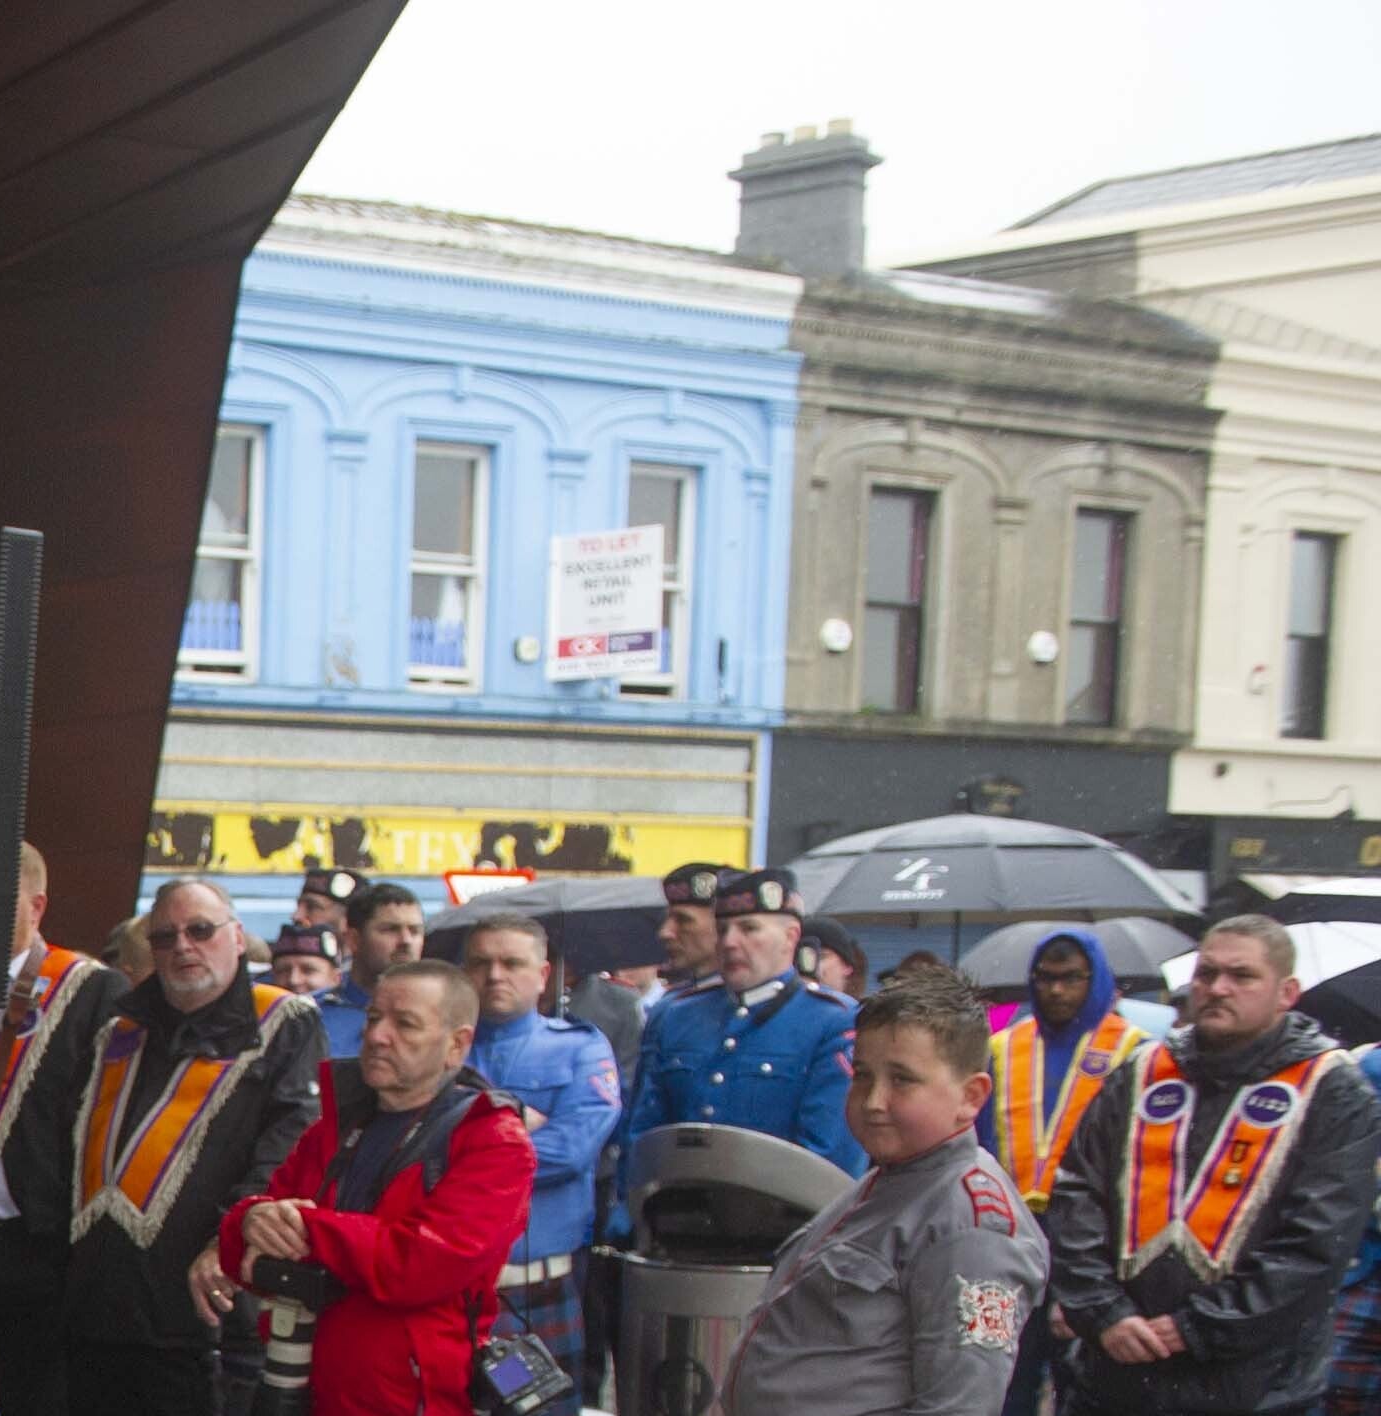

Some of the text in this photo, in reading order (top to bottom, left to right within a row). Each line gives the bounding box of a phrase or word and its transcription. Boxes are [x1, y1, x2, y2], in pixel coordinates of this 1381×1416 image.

[609, 531, 643, 551] LET
[564, 554, 651, 575] EXCELLENT
[588, 590, 624, 606] UNIT
